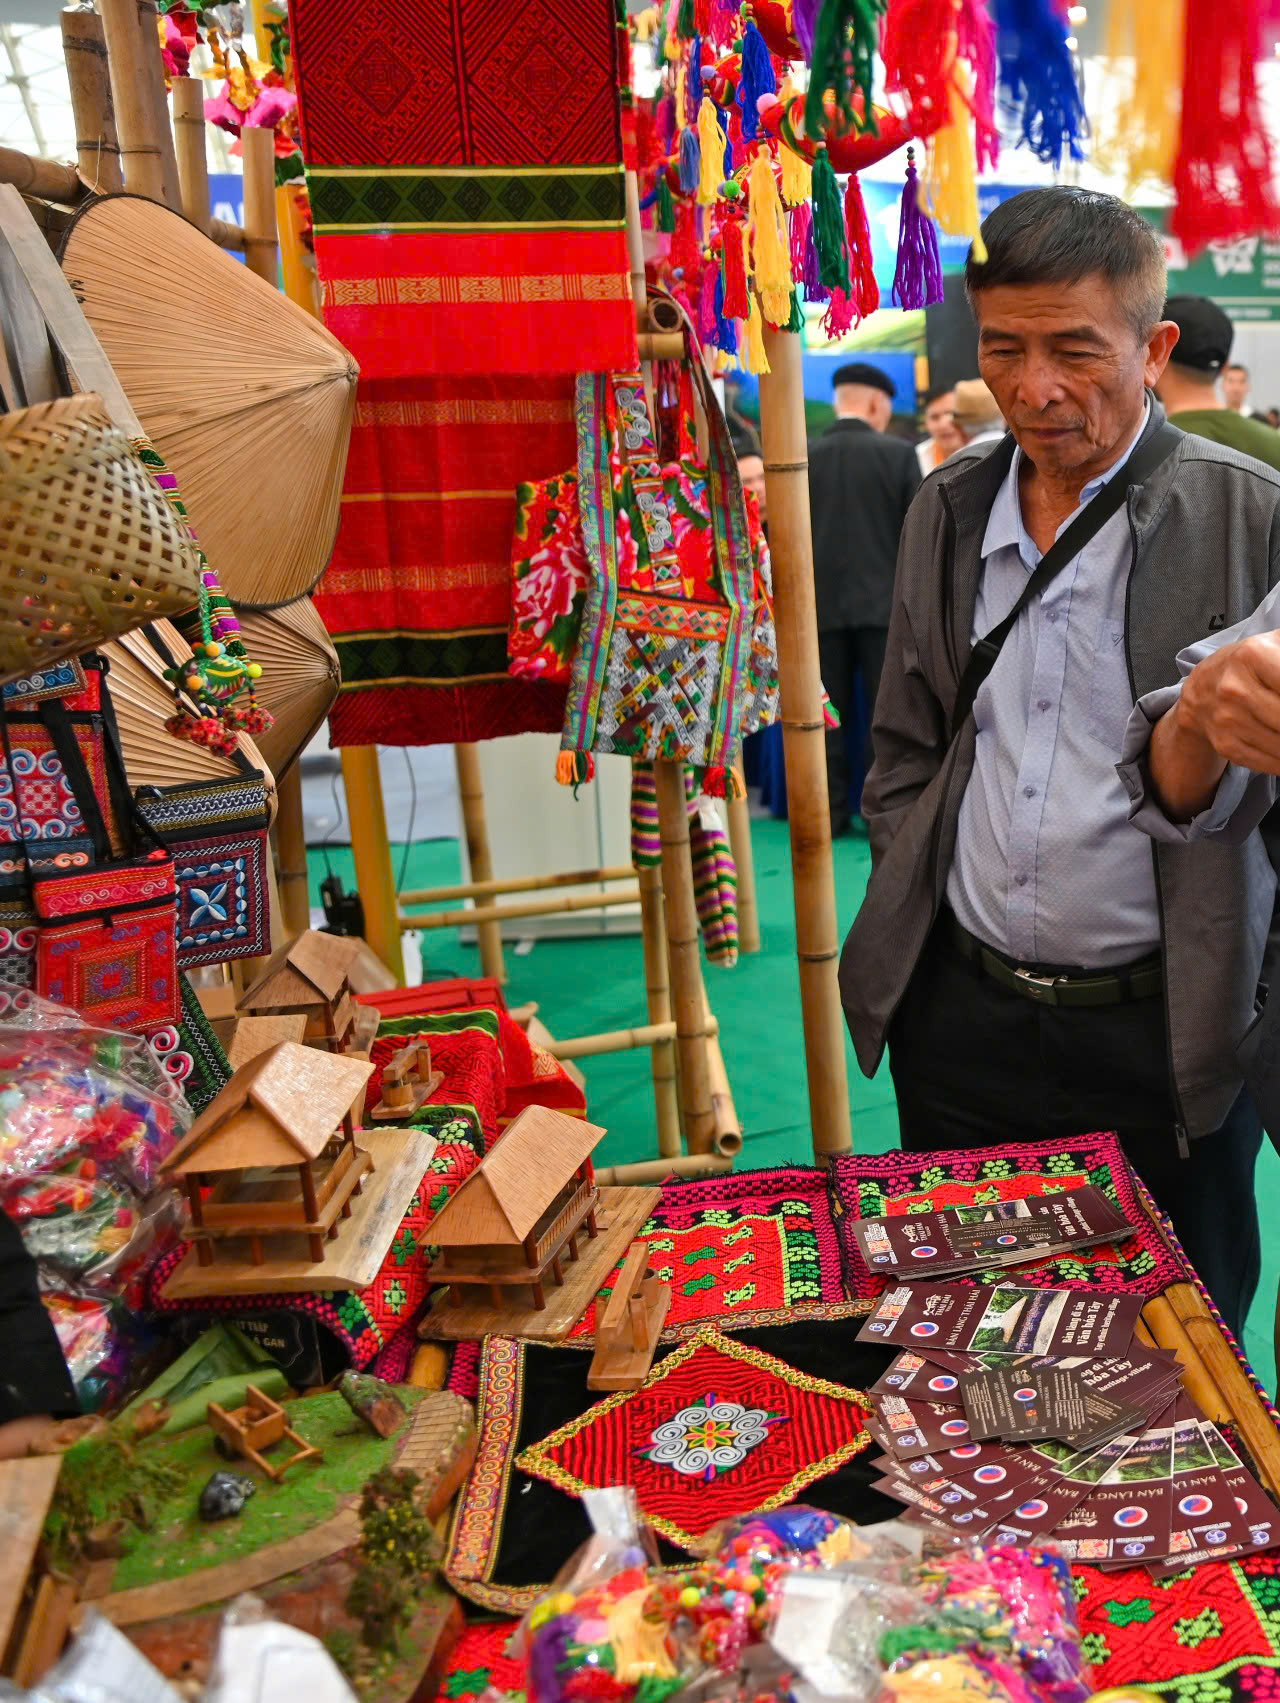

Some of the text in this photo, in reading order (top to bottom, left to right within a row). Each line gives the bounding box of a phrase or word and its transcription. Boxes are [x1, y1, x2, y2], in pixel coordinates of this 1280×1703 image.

[952, 1316, 968, 1333] LÀNG
[960, 1301, 975, 1317] THÁI
[968, 1289, 981, 1302] HẢI
[1073, 1301, 1086, 1311] sản
[1065, 1318, 1082, 1331] làng
[1076, 1301, 1104, 1345] Văn hóa Tày
[1061, 1331, 1075, 1343] Bản
[1082, 1360, 1132, 1386] hóa Tày
[1097, 1362, 1153, 1392] heritage village
[1097, 1490, 1133, 1500] LÀNG
